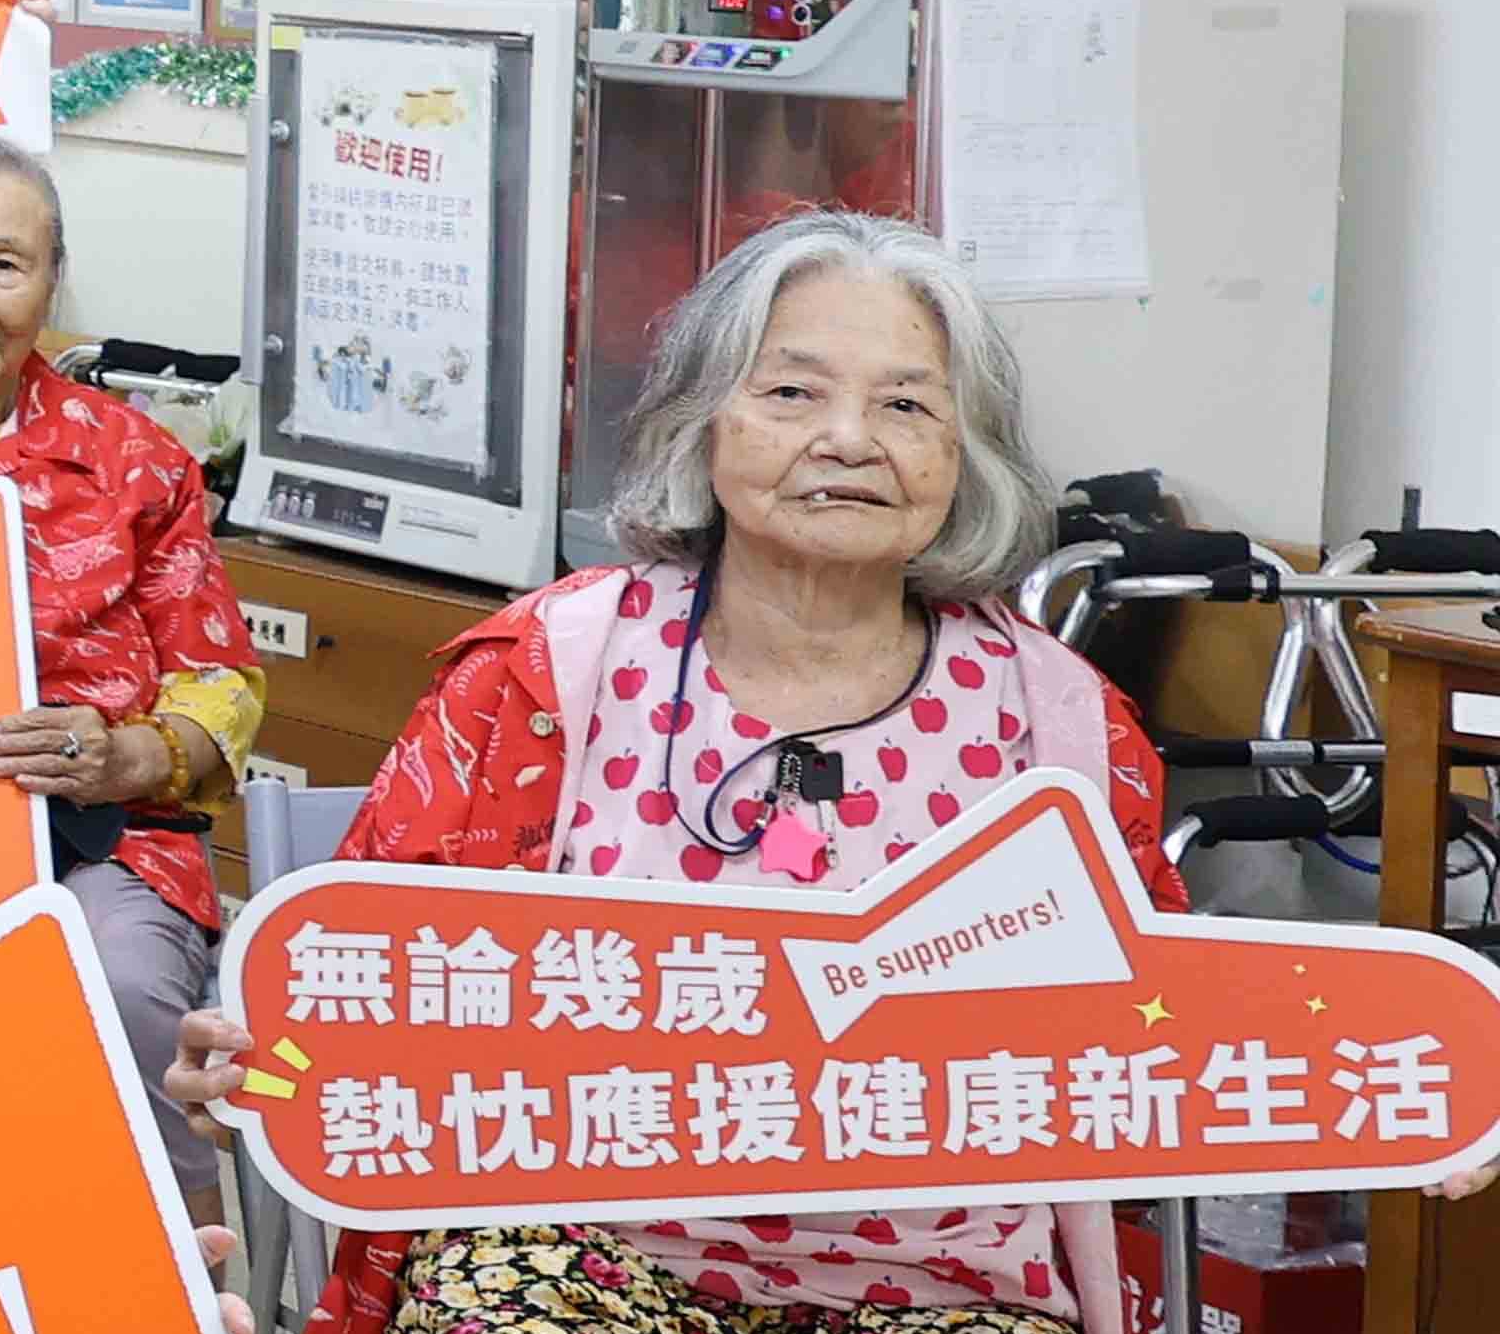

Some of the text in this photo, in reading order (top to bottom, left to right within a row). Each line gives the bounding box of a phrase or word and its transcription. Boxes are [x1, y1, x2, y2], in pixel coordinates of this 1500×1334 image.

[334, 129, 444, 182] 歡迎使用!
[284, 919, 769, 1037] 無論幾歲
[824, 890, 1066, 997] Be supporters!
[317, 1032, 1454, 1176] 熱忱應援健康新生活
